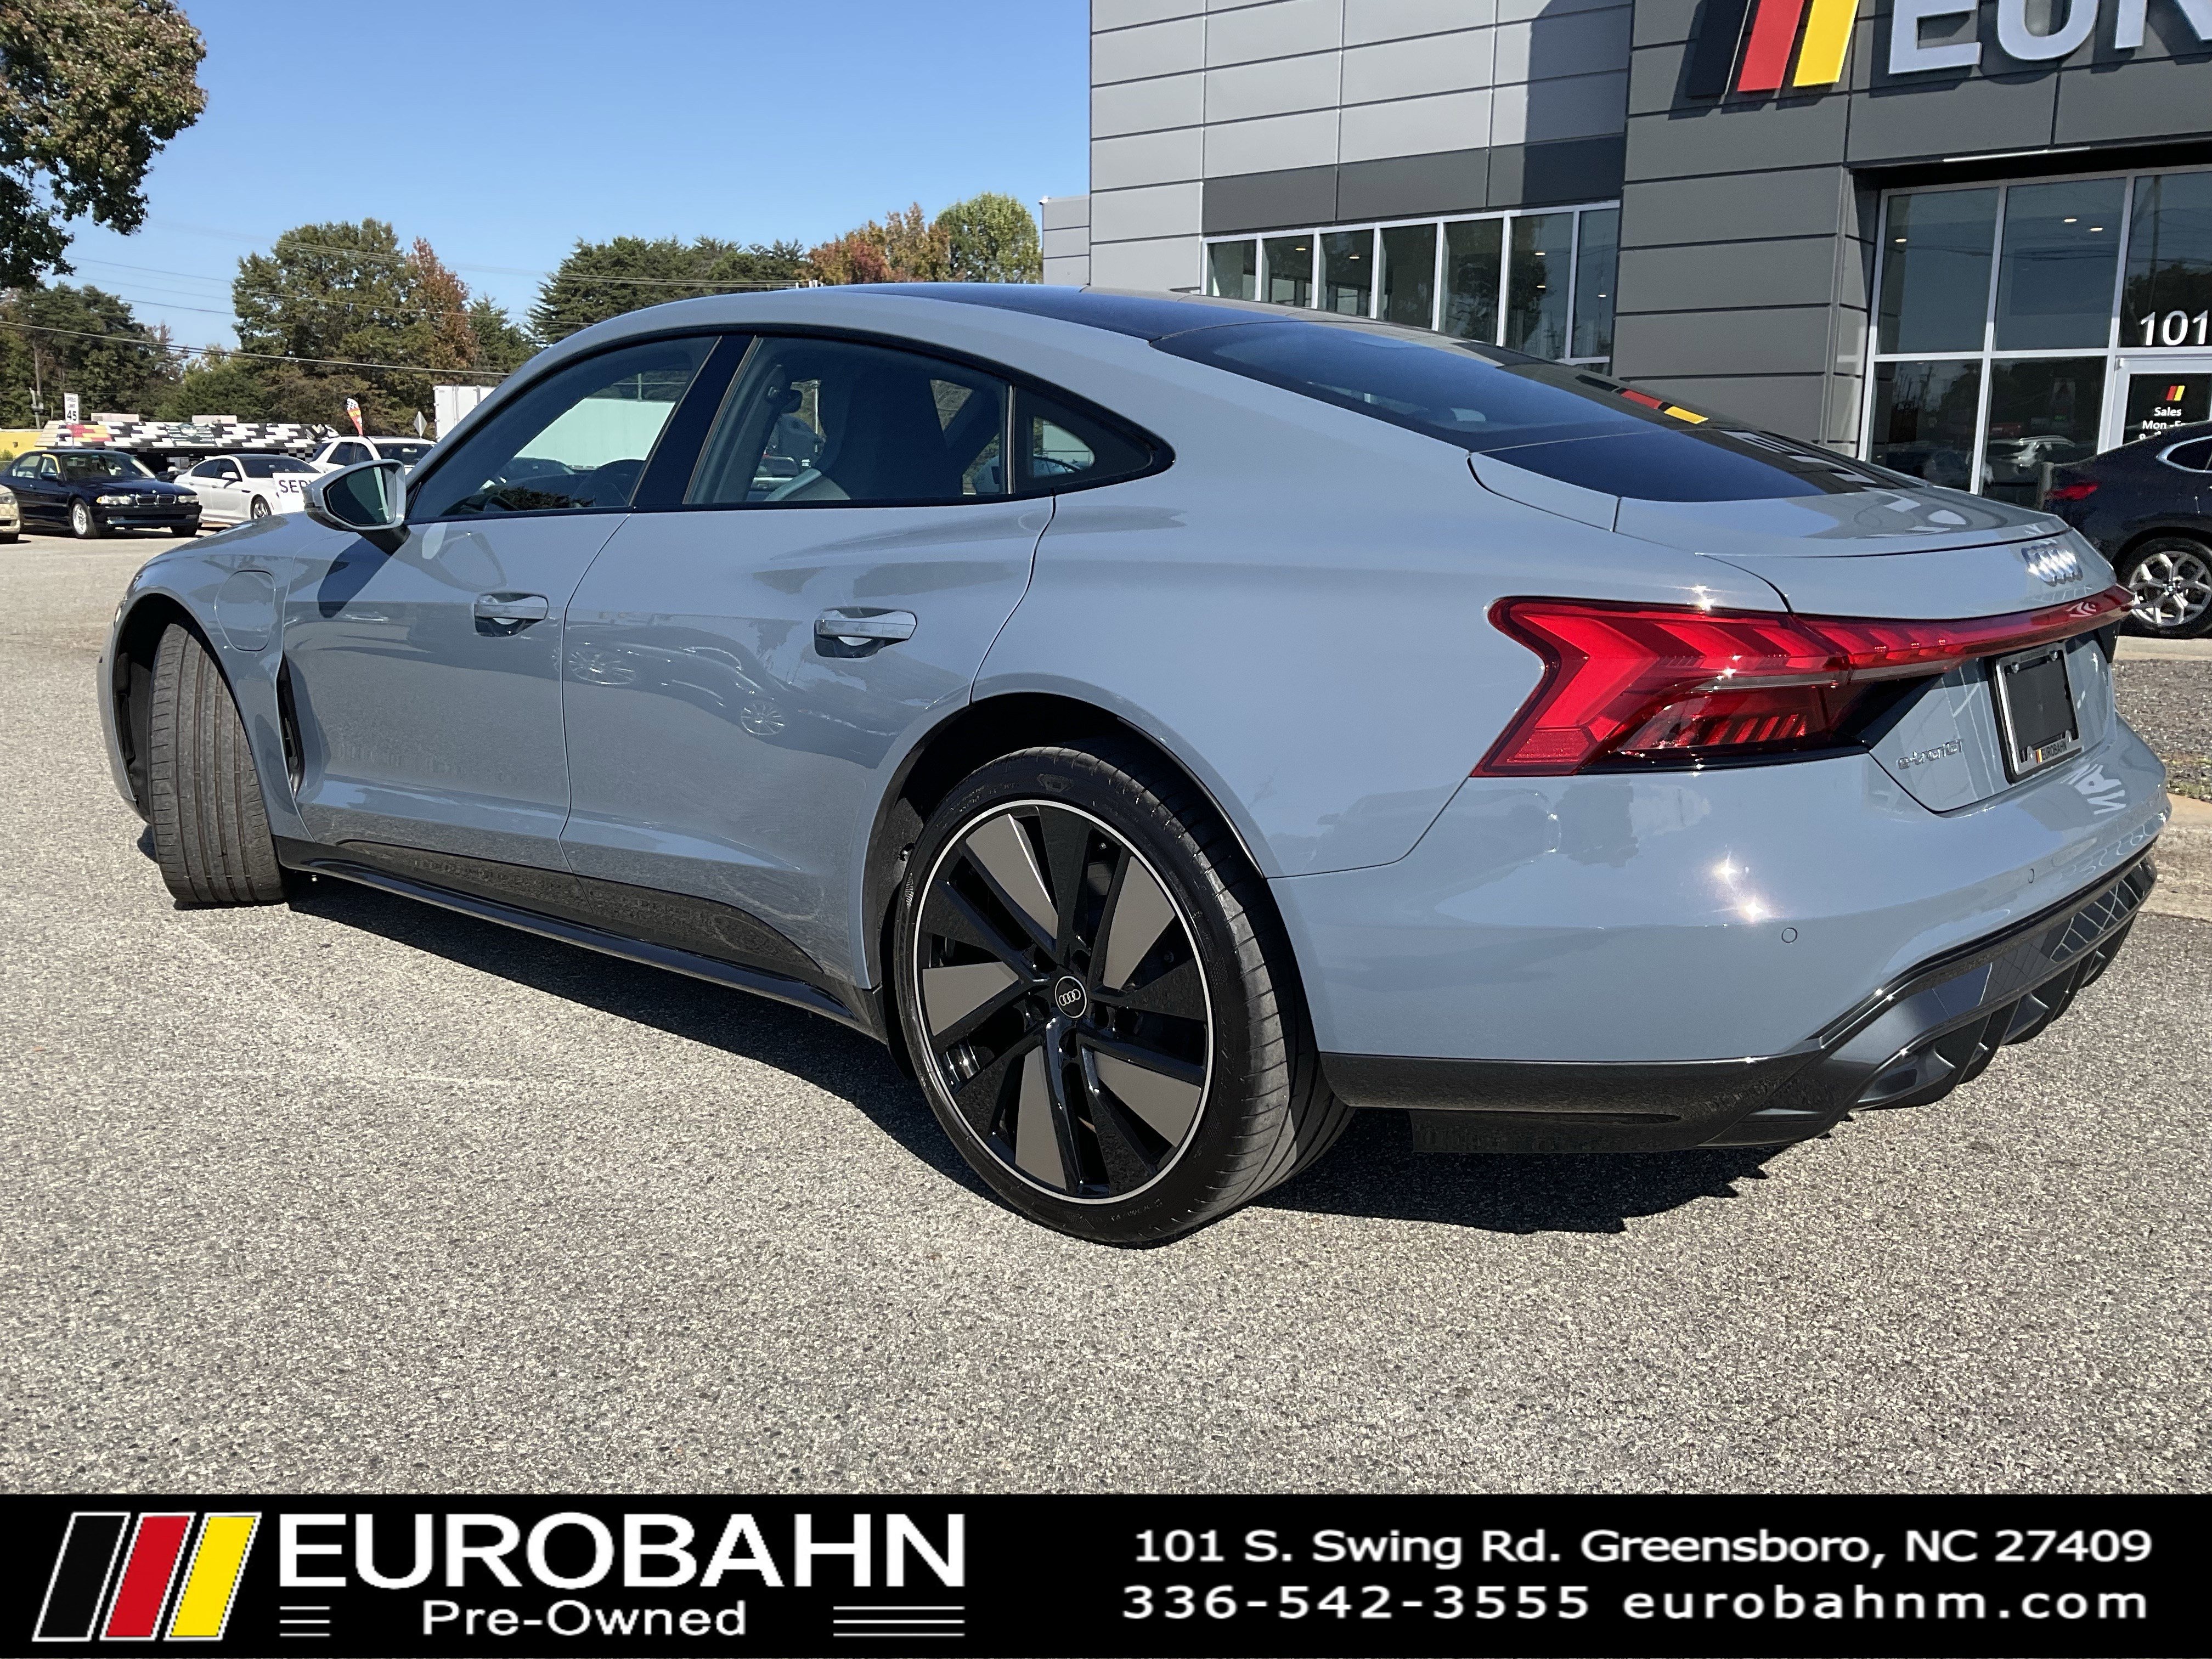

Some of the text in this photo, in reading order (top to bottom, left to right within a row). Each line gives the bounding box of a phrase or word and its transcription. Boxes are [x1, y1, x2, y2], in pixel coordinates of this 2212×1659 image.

[2141, 310, 2208, 346] 101
[67, 410, 77, 421] 45
[2154, 407, 2182, 416] Sales
[2142, 420, 2167, 429] Mon
[279, 479, 311, 493] SER
[2041, 740, 2068, 760] EUROBAHN
